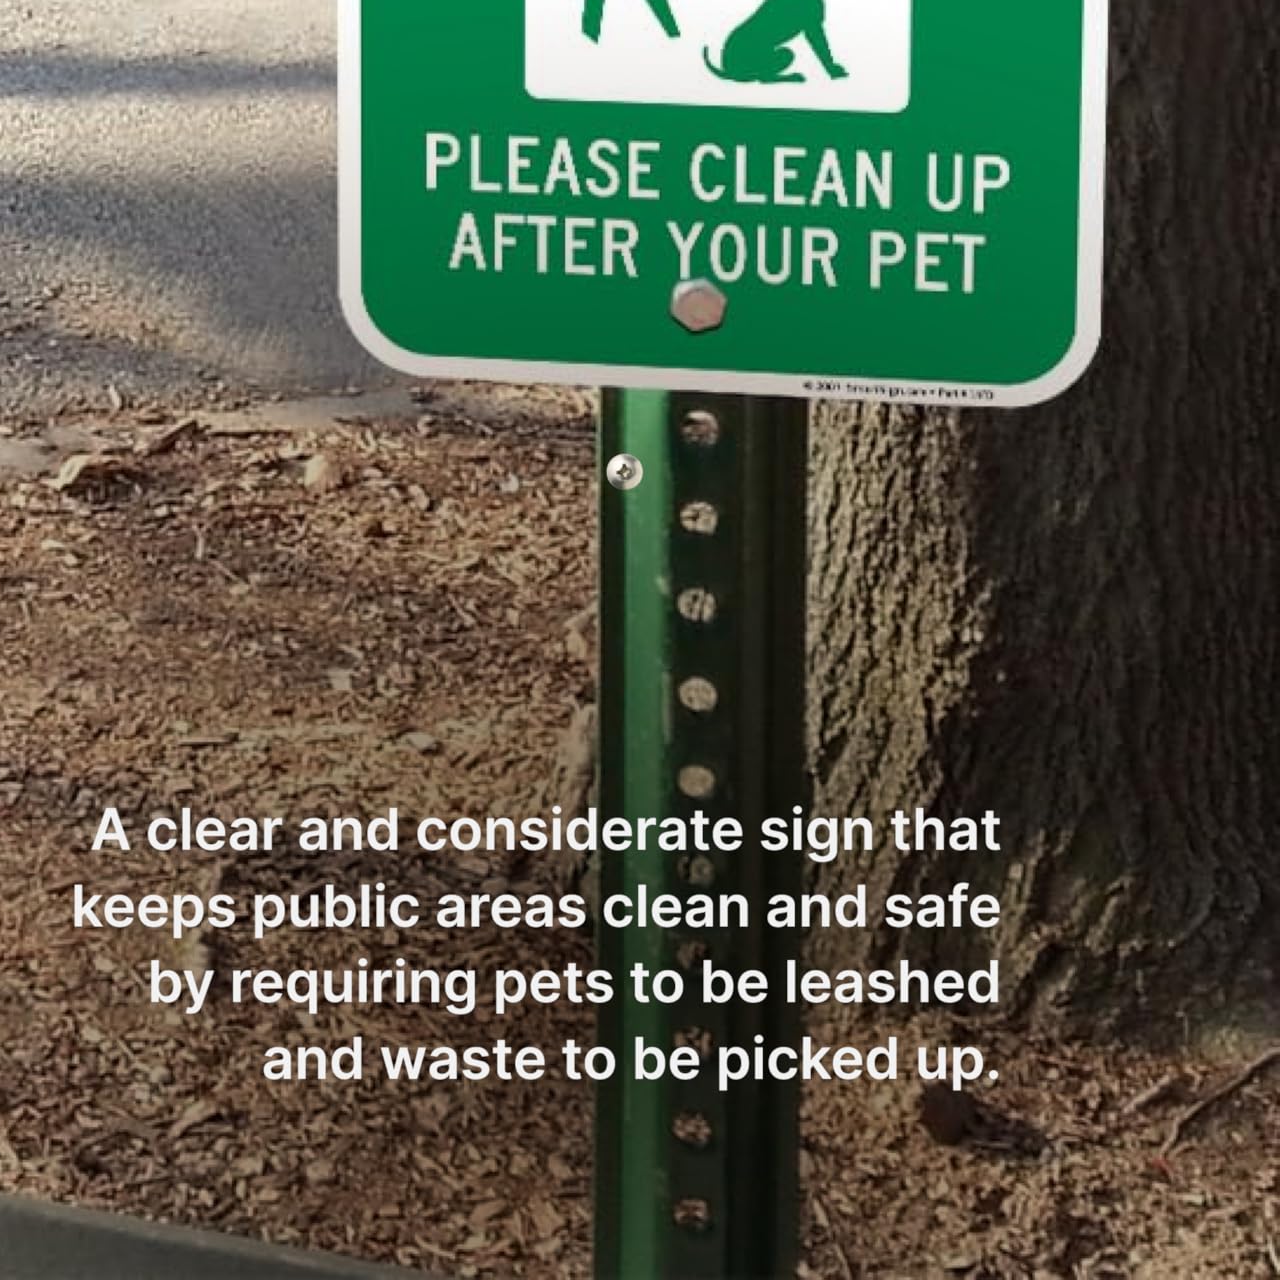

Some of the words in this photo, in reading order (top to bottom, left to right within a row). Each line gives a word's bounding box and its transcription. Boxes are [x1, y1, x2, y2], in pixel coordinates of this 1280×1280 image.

[426, 132, 660, 199] PLEASE
[690, 144, 892, 209] CLEAN
[928, 153, 1010, 213] UP
[449, 212, 639, 277] AFTER
[667, 222, 839, 287] YOUR
[870, 231, 985, 292] PET
